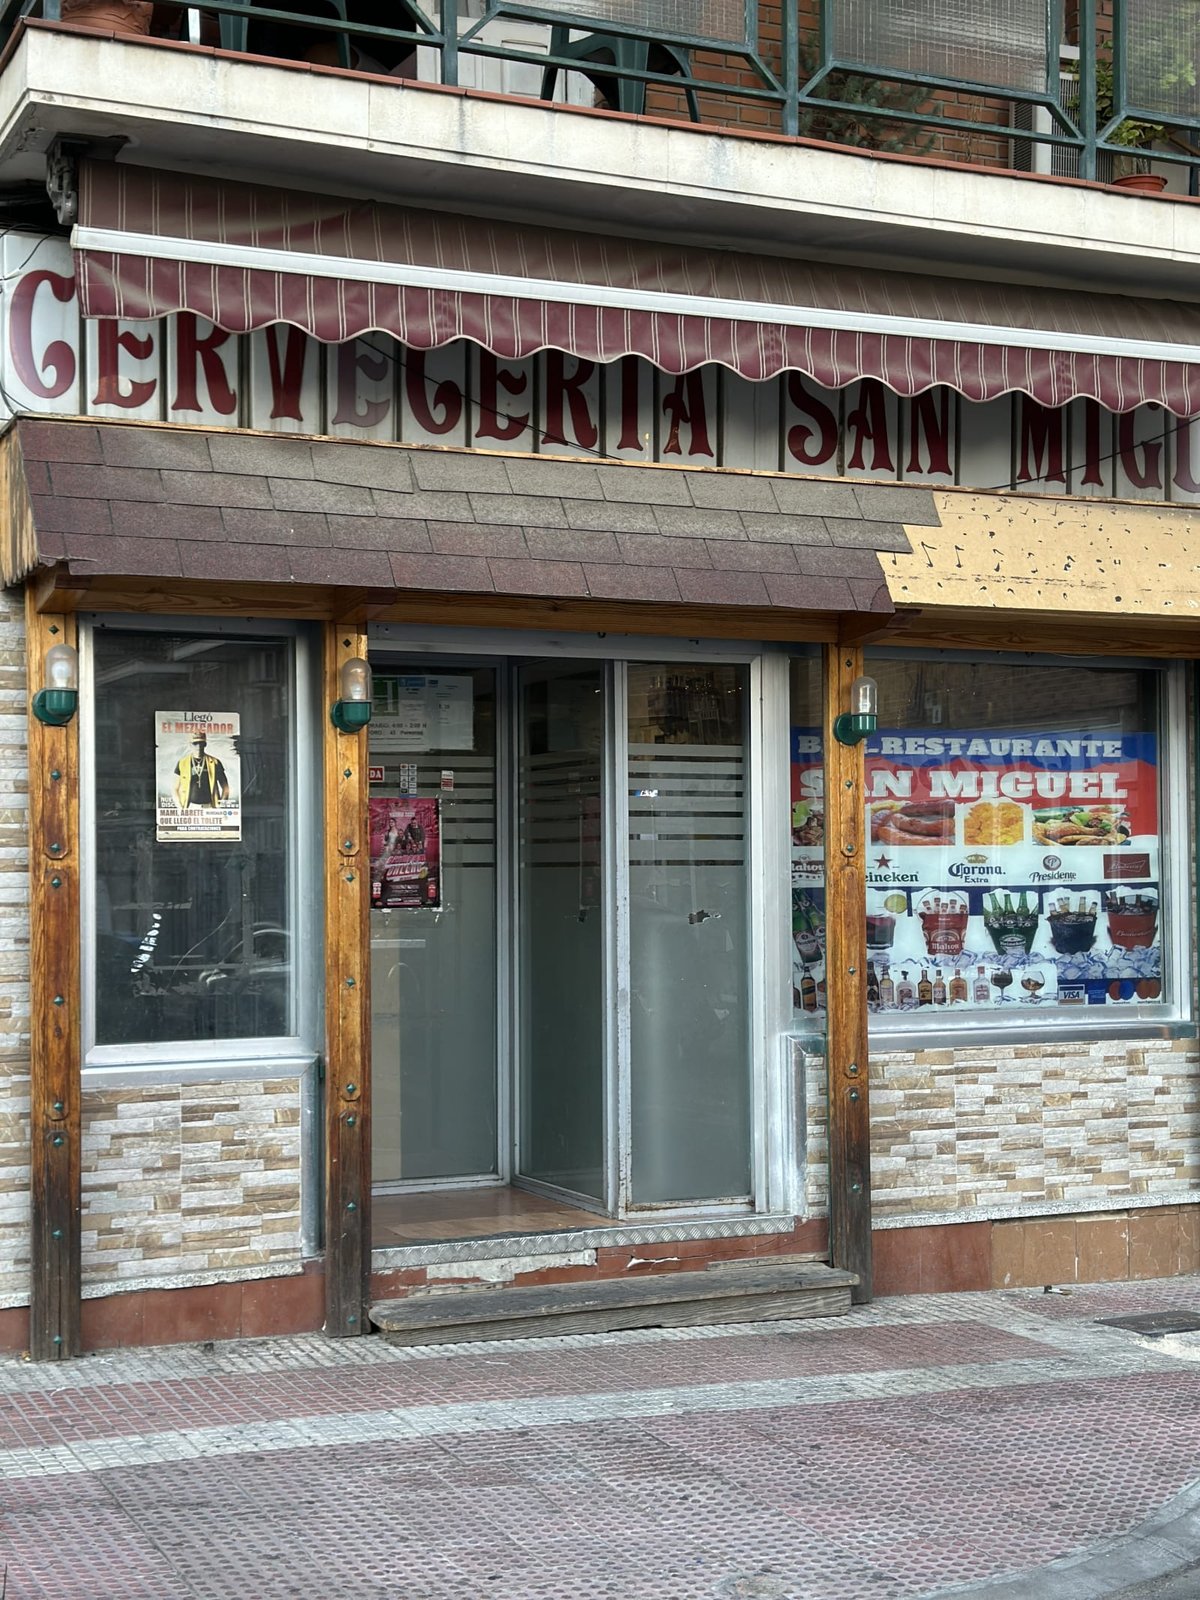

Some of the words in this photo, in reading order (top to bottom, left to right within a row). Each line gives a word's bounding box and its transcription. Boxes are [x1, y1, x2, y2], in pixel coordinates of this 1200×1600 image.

[10, 270, 714, 457] CERVECERIA
[788, 372, 952, 475] SAN
[184, 712, 213, 723] Llegó
[798, 735, 1122, 758] B-RESTAURANTE
[801, 769, 914, 798] SN
[928, 770, 1128, 799] MIGUEL
[865, 871, 919, 883] eineken
[964, 876, 989, 884] Extra
[1029, 871, 1077, 883] Presidente
[1063, 990, 1080, 999] VISA
